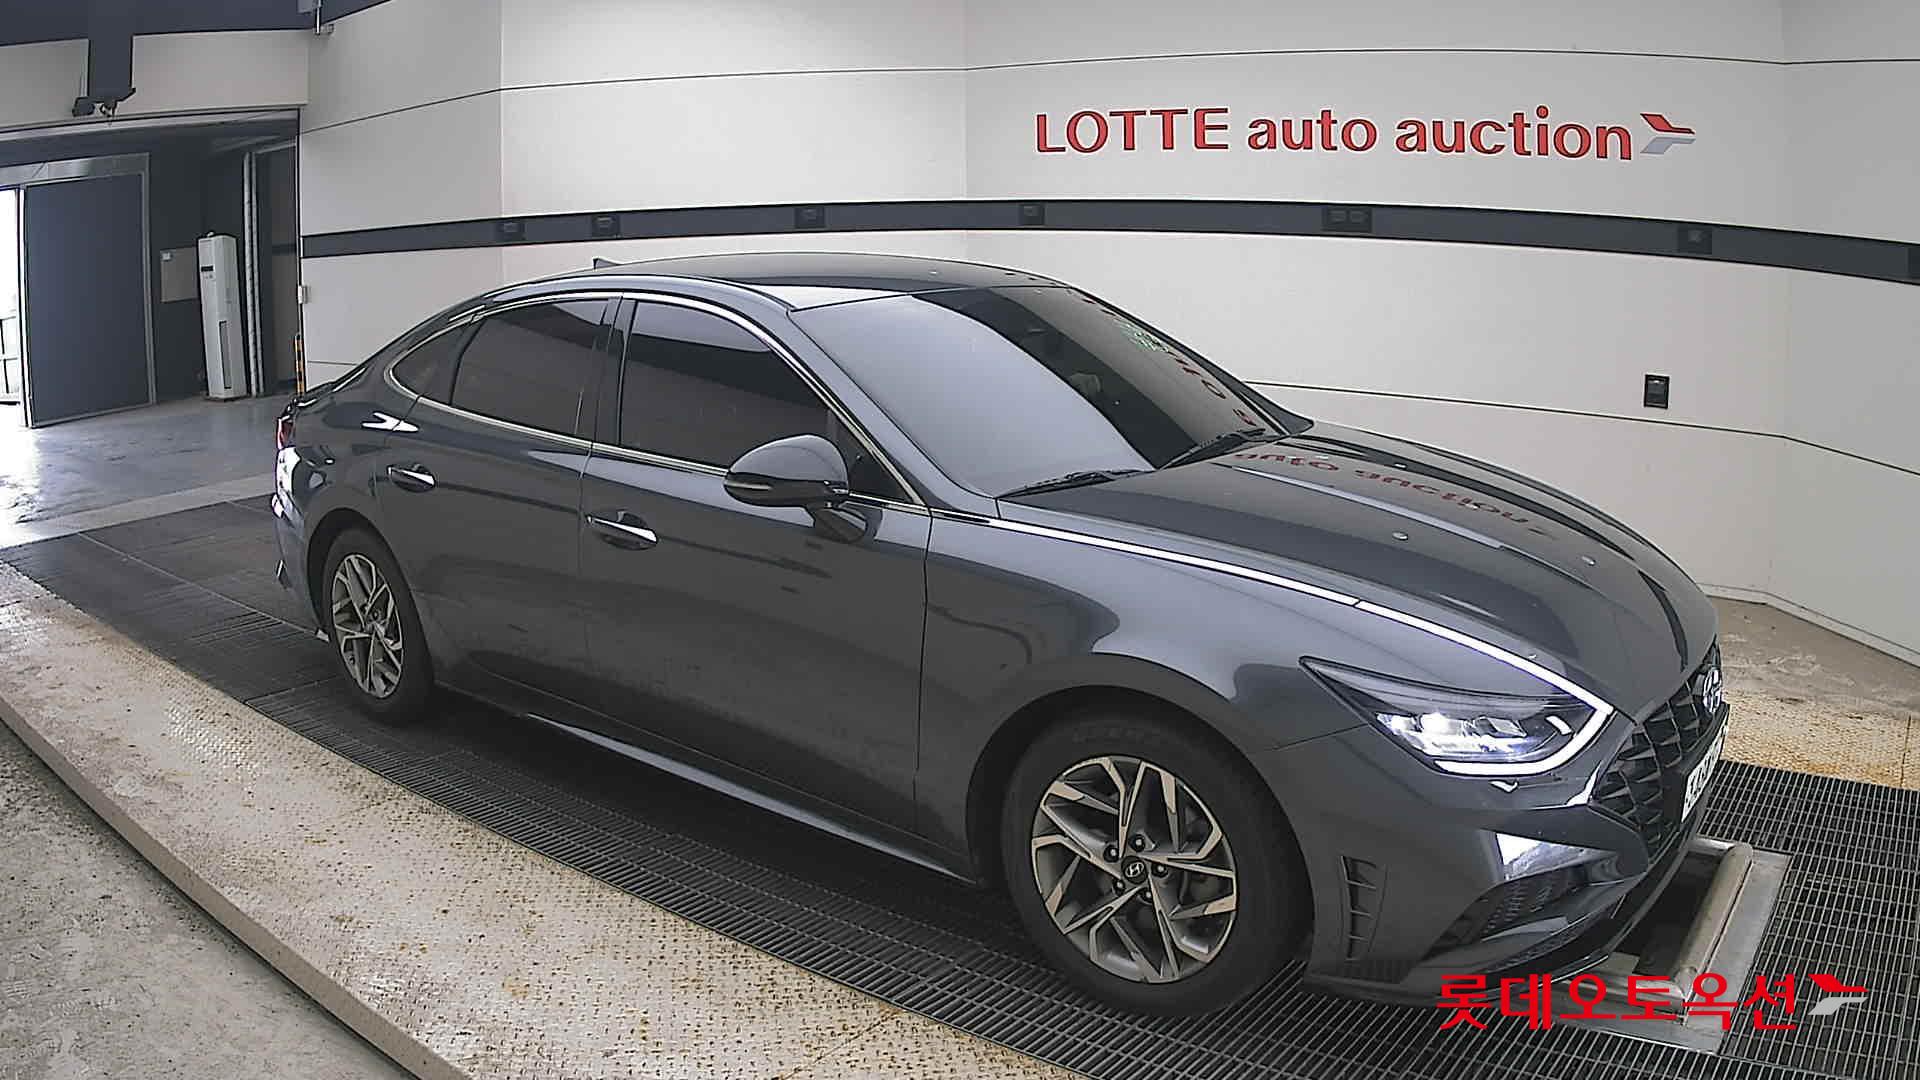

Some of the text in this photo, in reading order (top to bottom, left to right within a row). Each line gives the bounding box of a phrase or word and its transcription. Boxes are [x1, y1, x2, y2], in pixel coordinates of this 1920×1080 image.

[1035, 105, 1633, 161] LOTTE auto auction
